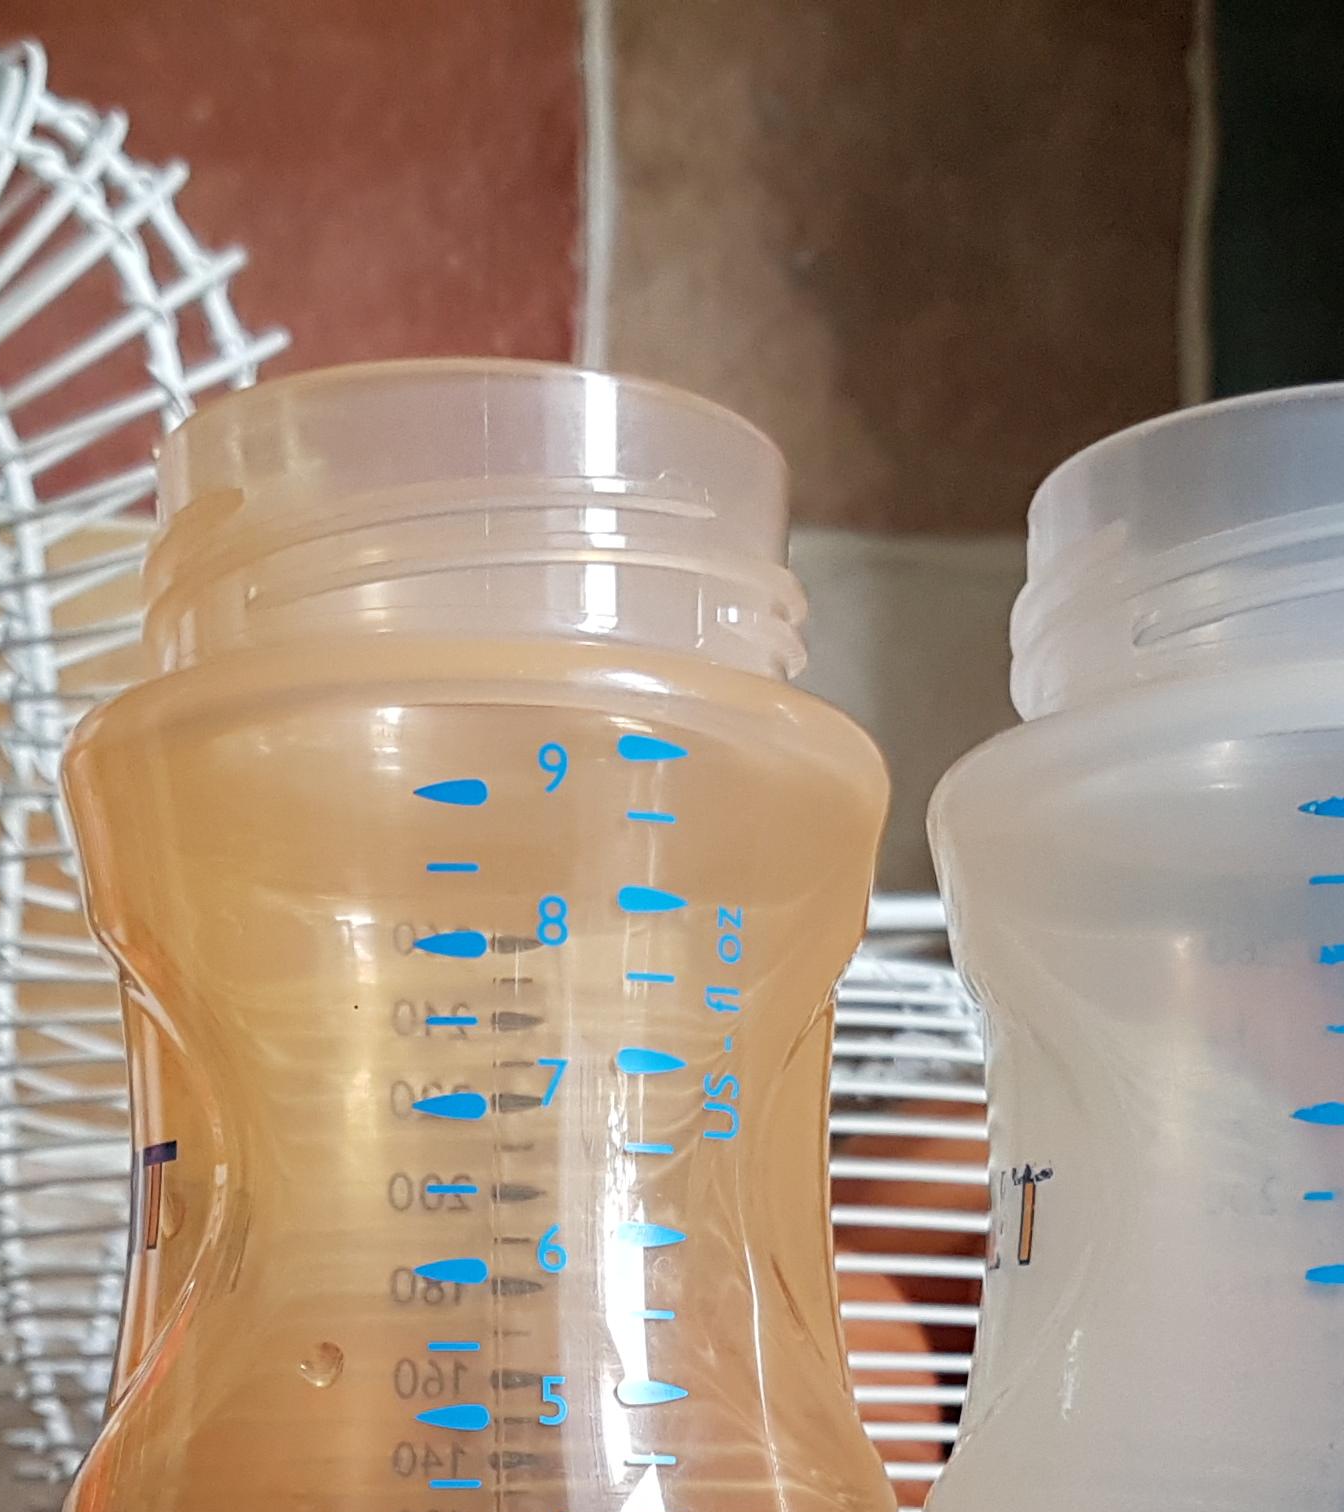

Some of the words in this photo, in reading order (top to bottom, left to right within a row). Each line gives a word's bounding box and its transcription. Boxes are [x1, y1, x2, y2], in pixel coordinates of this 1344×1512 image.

[538, 742, 569, 793] 9
[536, 895, 569, 947] 8
[718, 907, 743, 964] oz
[705, 986, 740, 1012] fl
[537, 1058, 569, 1107] 7
[703, 1074, 740, 1140] US
[537, 1223, 568, 1273] 6
[539, 1375, 568, 1426] 5
